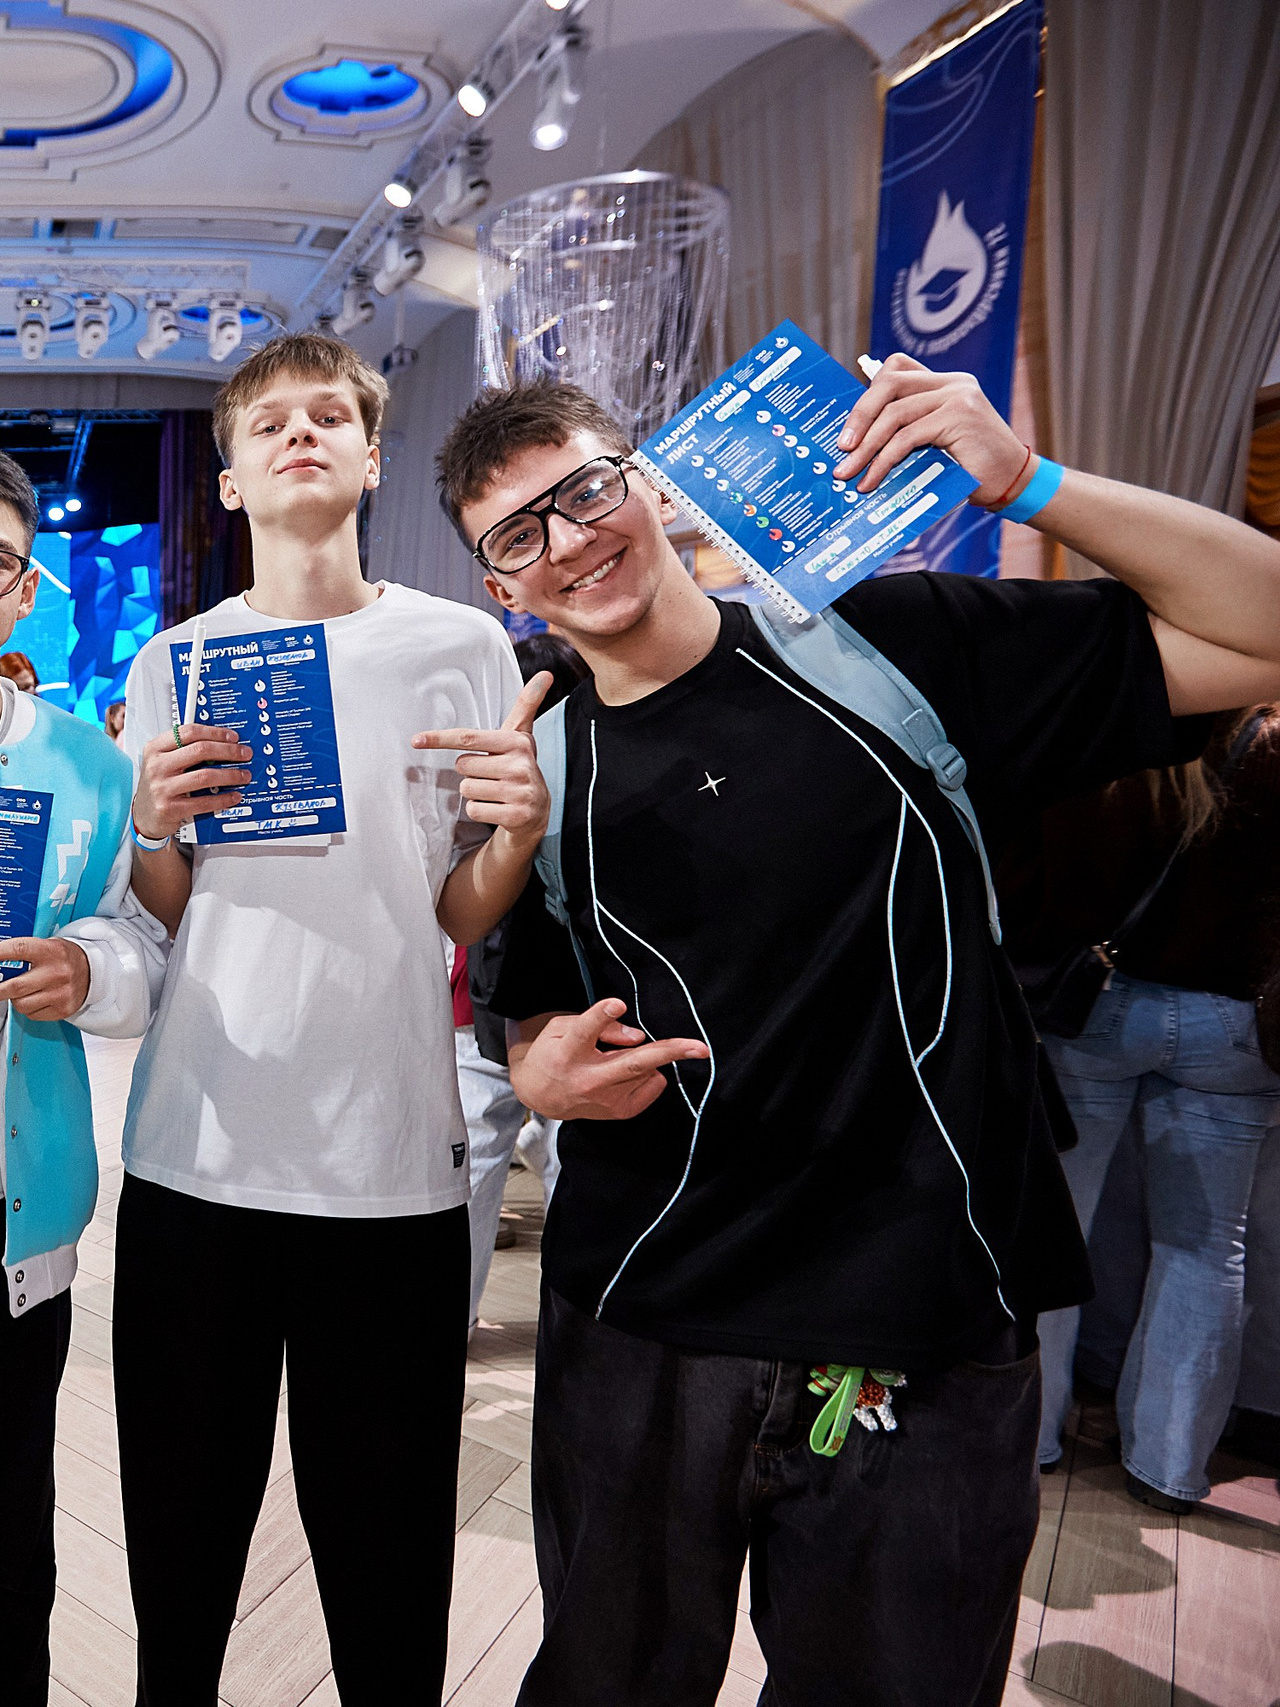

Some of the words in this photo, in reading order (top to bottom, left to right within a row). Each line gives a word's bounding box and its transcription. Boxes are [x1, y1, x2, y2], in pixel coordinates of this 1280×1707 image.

[653, 382, 737, 456] МАРШРУТНЫЙ
[665, 433, 699, 465] ЛИСТ
[824, 508, 865, 541] Отрывная
[863, 491, 887, 511] часть
[179, 642, 258, 662] МШРУТНЫЙ
[182, 663, 211, 675] ЛСТ
[240, 795, 273, 804] Отрывная
[274, 793, 294, 801] часть
